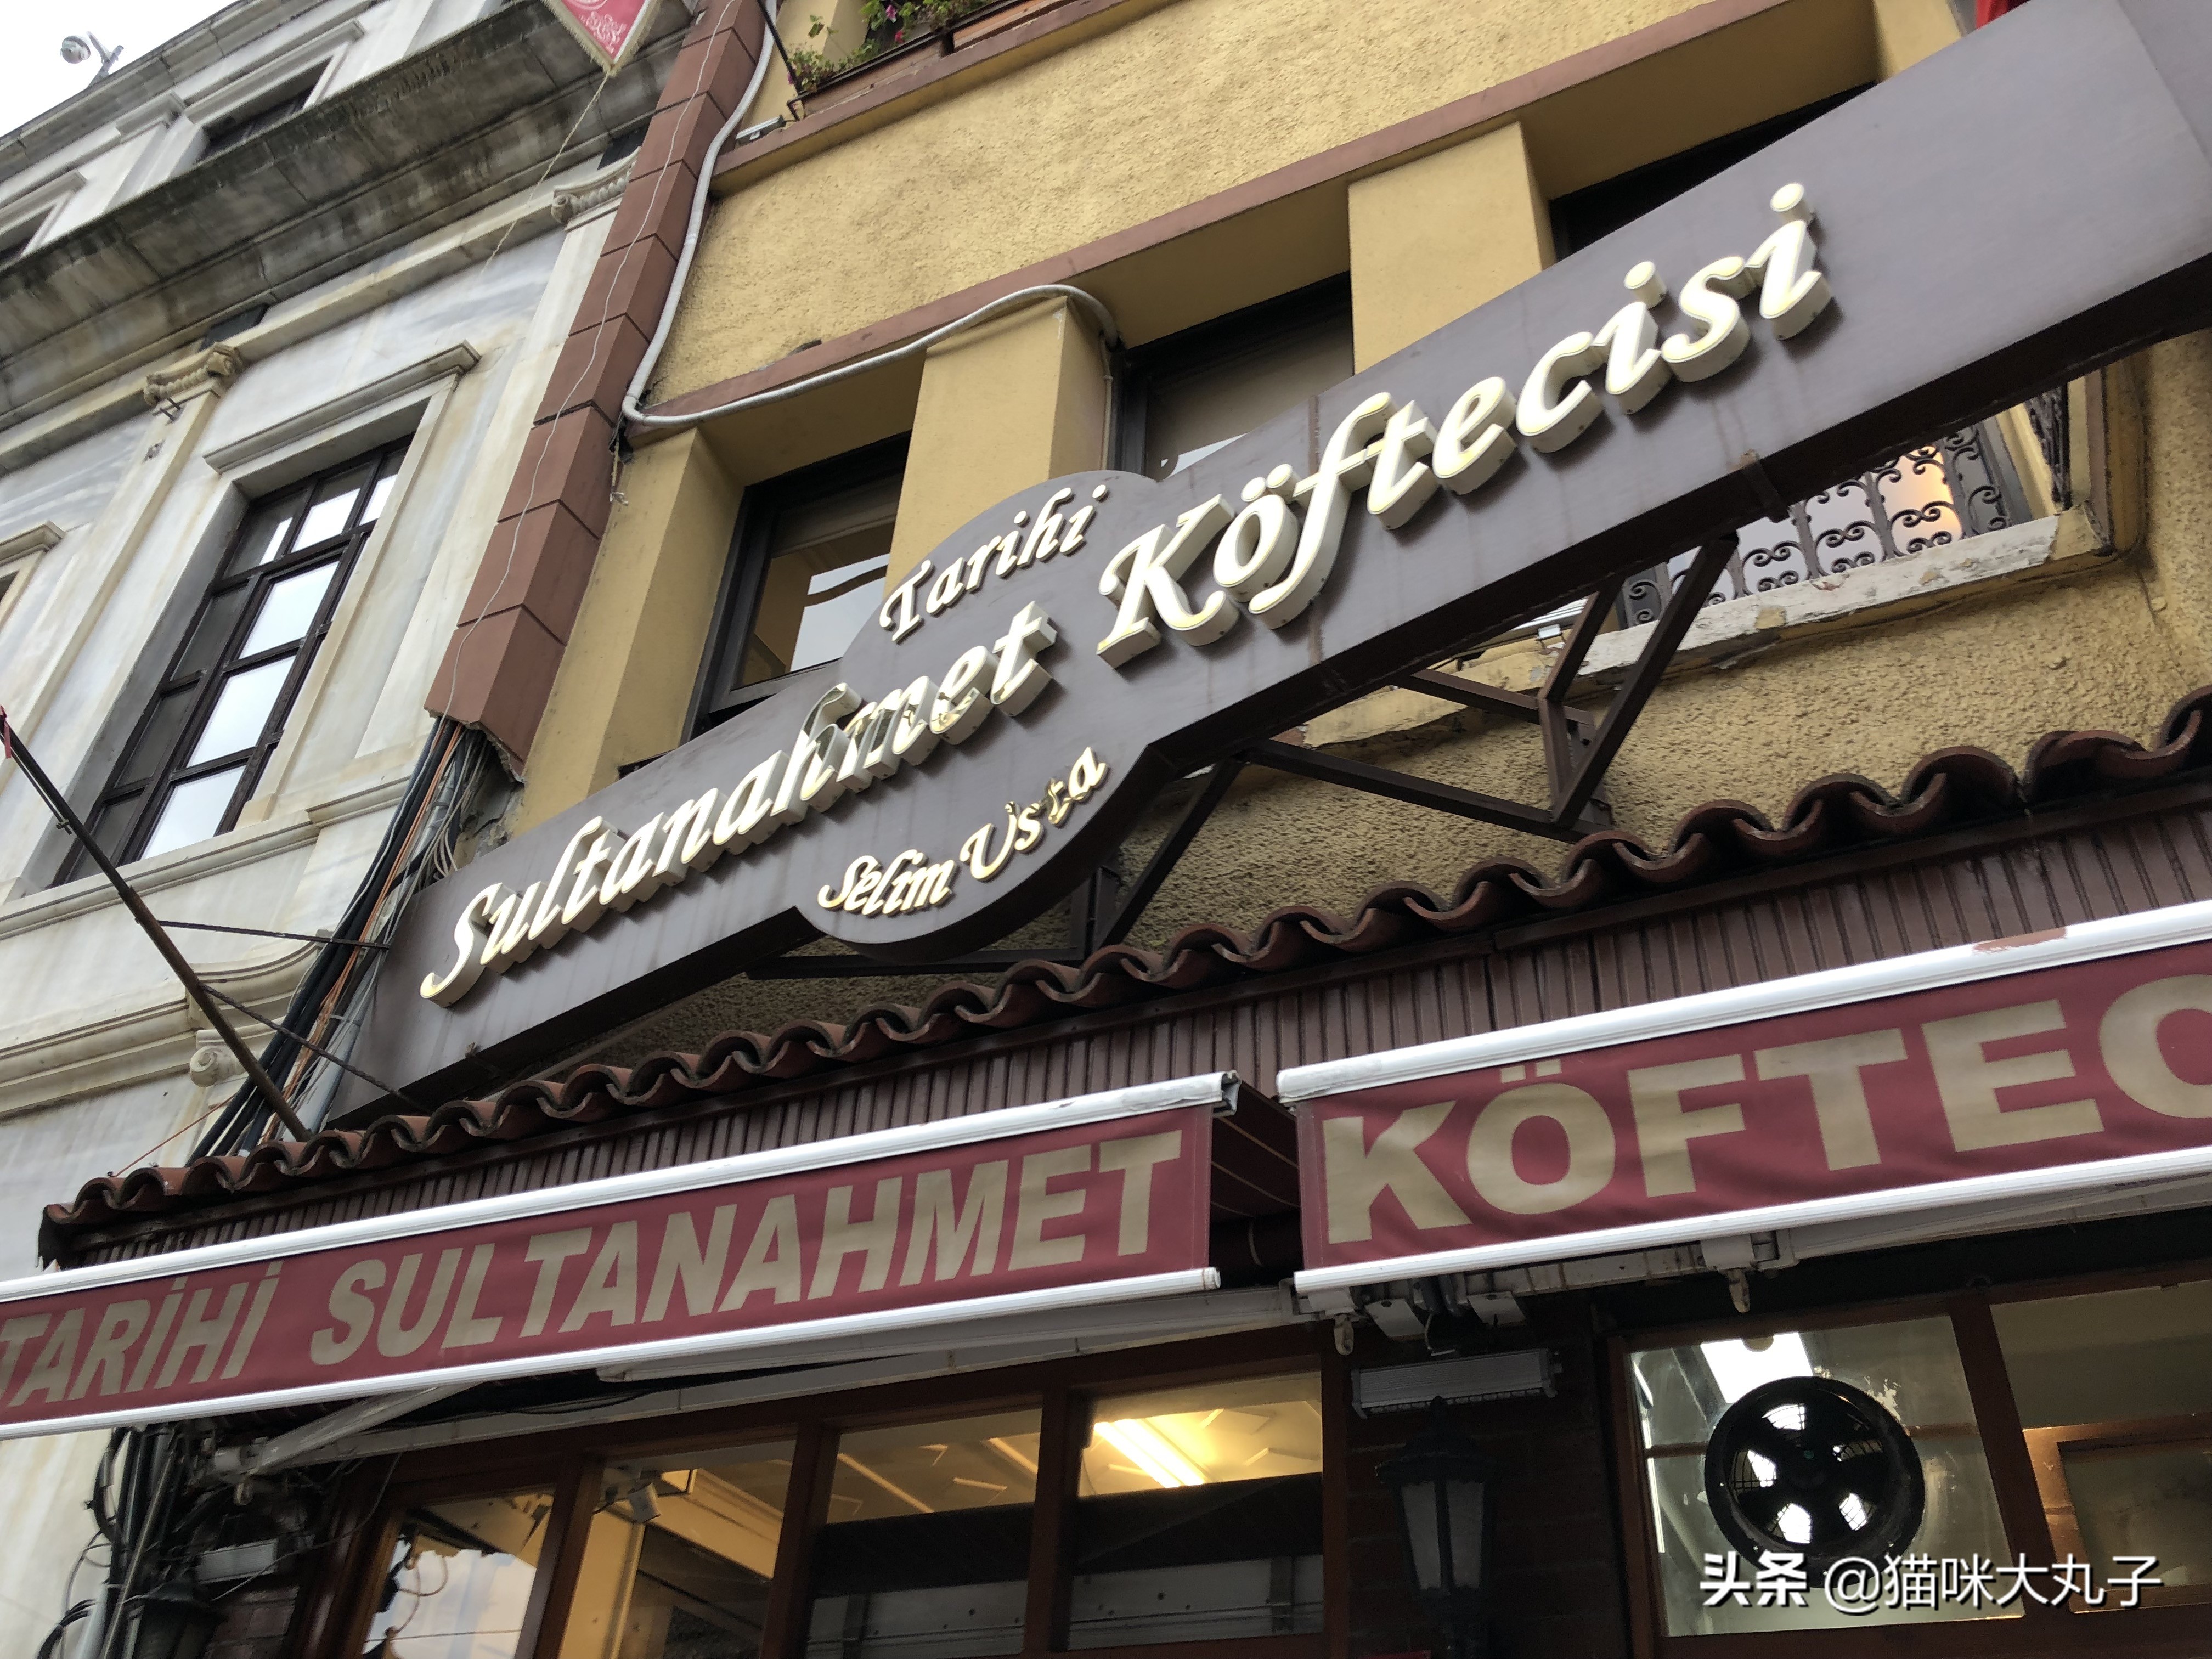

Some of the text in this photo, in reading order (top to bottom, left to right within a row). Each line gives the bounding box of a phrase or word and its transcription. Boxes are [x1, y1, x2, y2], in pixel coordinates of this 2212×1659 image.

[420, 182, 1831, 1006] Sultanahmet Köftecisi
[879, 484, 1108, 642] Tarihi
[817, 746, 1109, 916] Selim Usta
[0, 1129, 1182, 1408] TARİHİ SULTANAHMET
